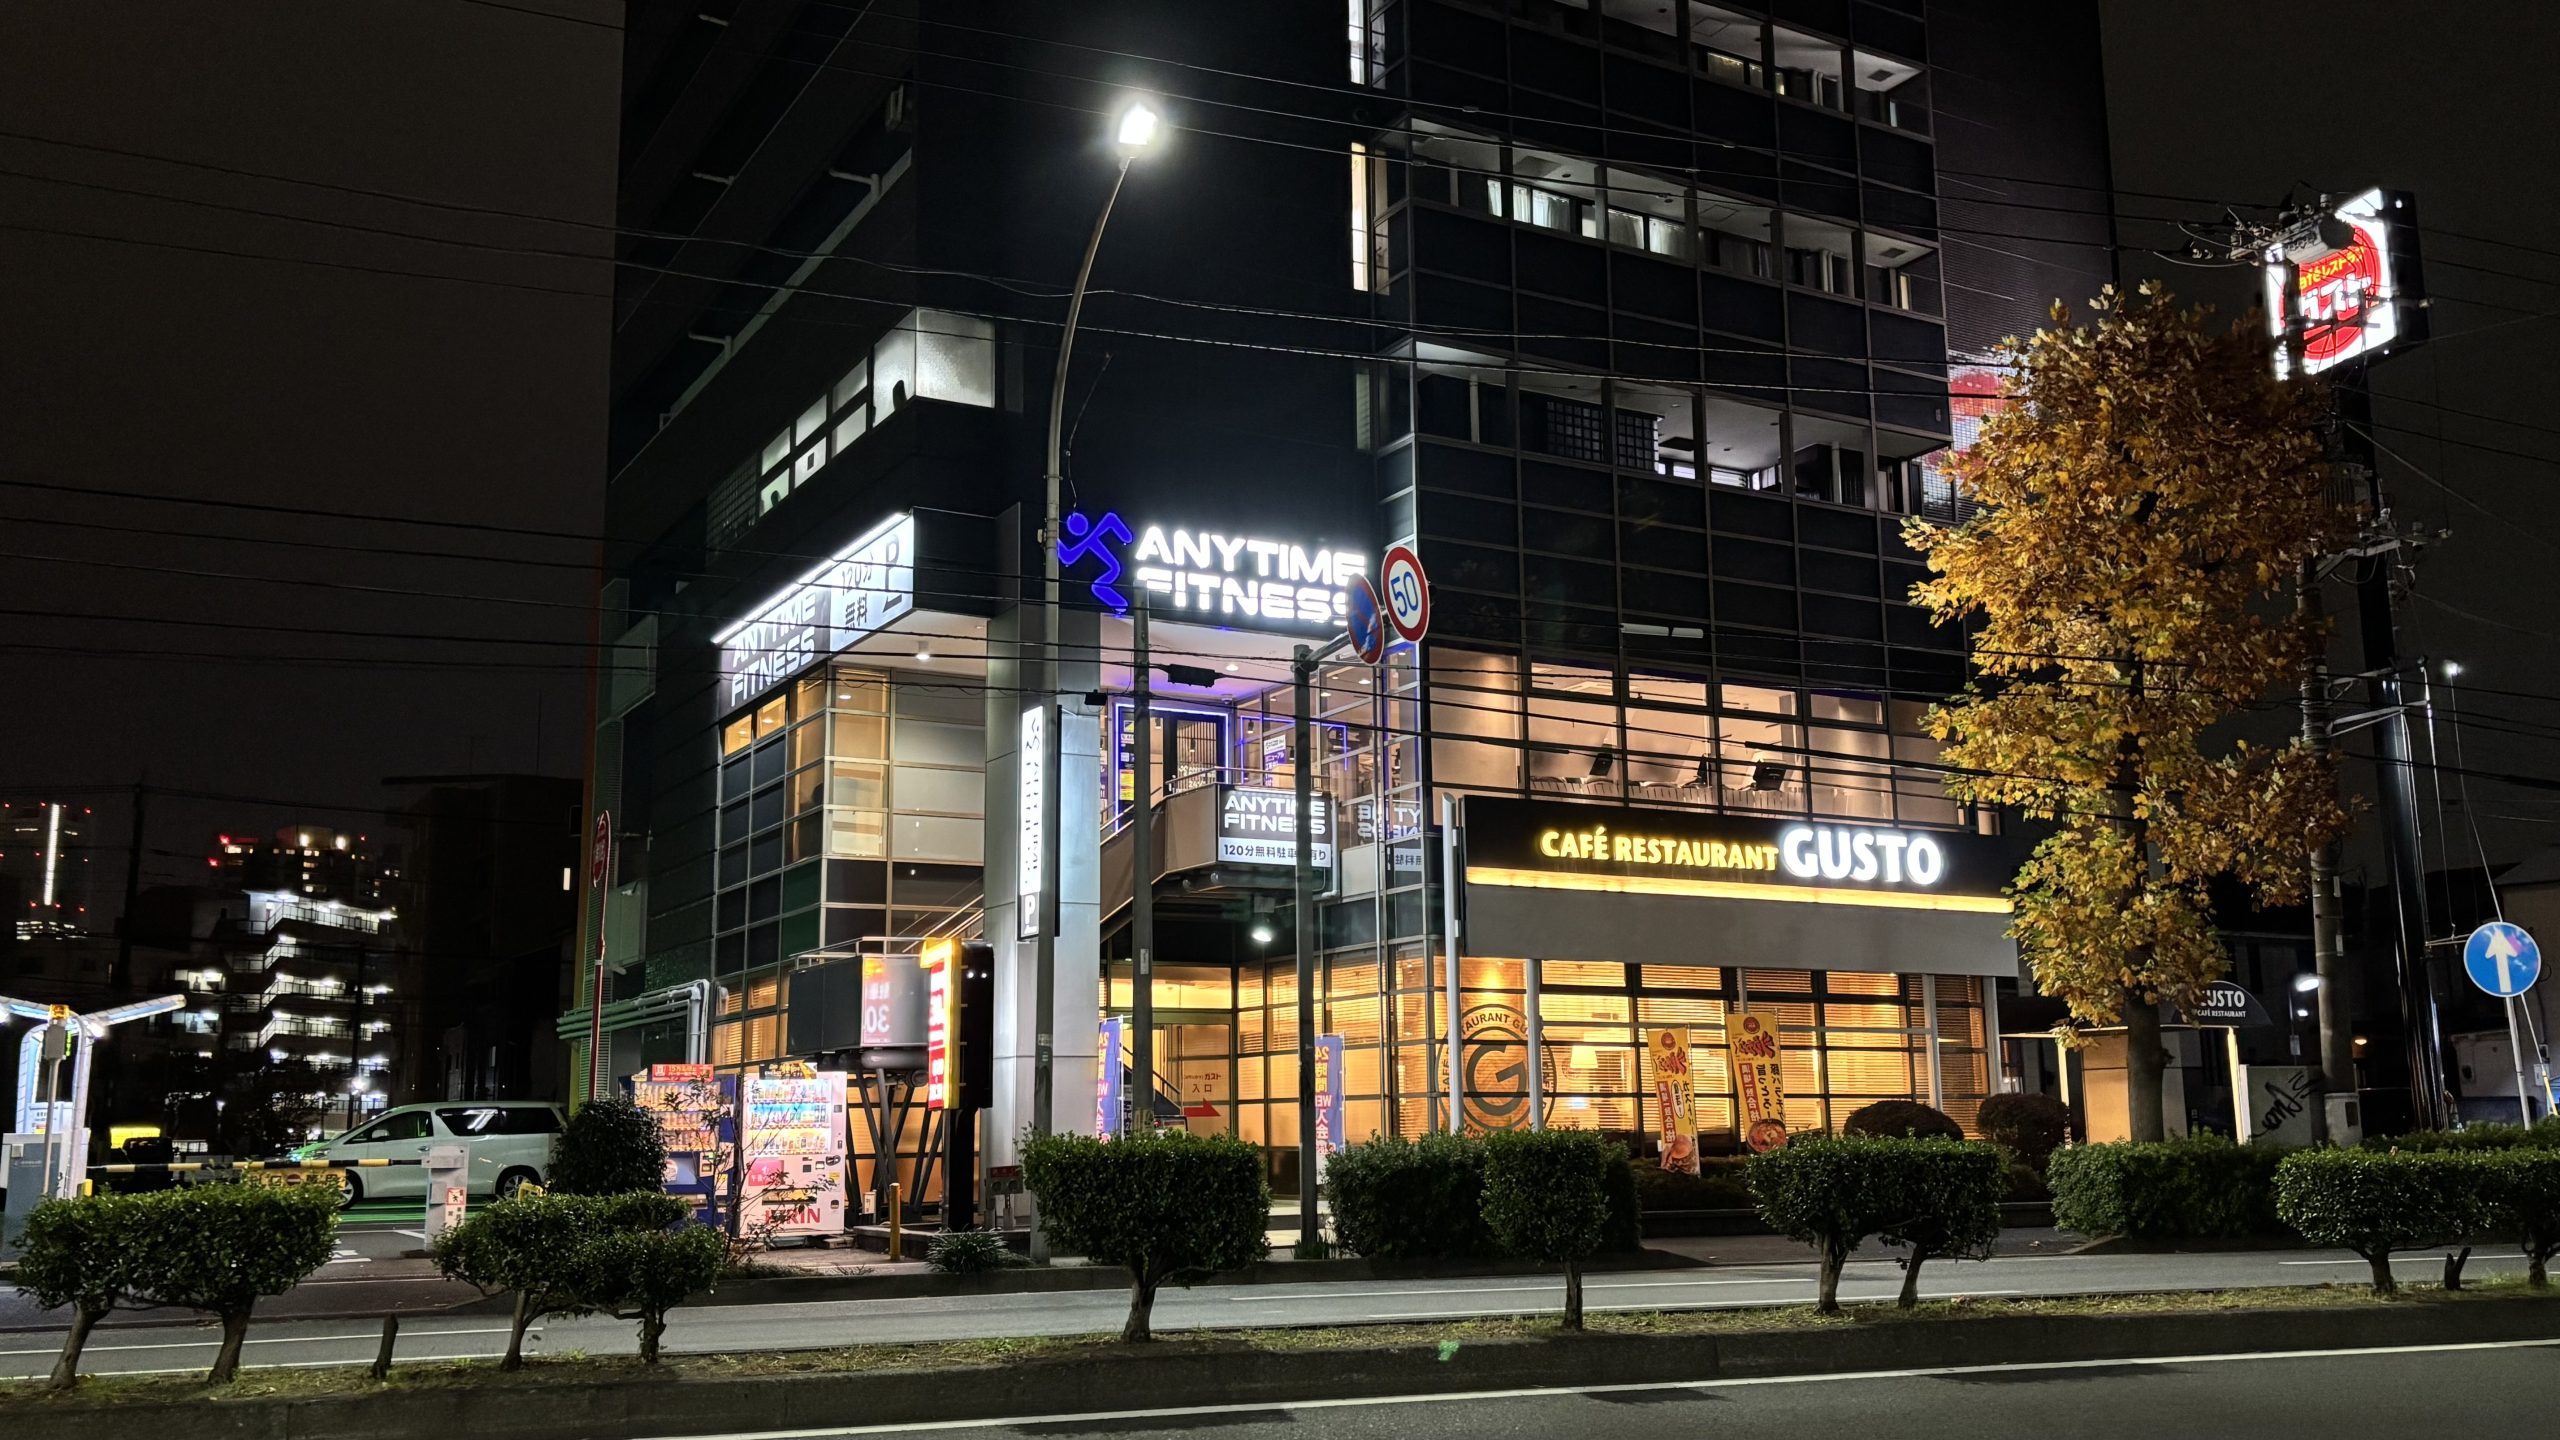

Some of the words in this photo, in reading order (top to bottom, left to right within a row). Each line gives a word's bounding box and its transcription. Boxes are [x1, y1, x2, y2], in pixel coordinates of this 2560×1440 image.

[1135, 526, 1366, 585] ANYTIME
[844, 593, 868, 634] 無料
[1391, 571, 1419, 618] 50
[733, 592, 816, 668] ANYTIME
[731, 626, 815, 707] FITNESS
[1541, 826, 1610, 860] CAFÉ
[1614, 836, 1779, 871] RESTAURANT
[1783, 828, 1942, 886] GUSTO
[1192, 1083, 1212, 1093] 入口
